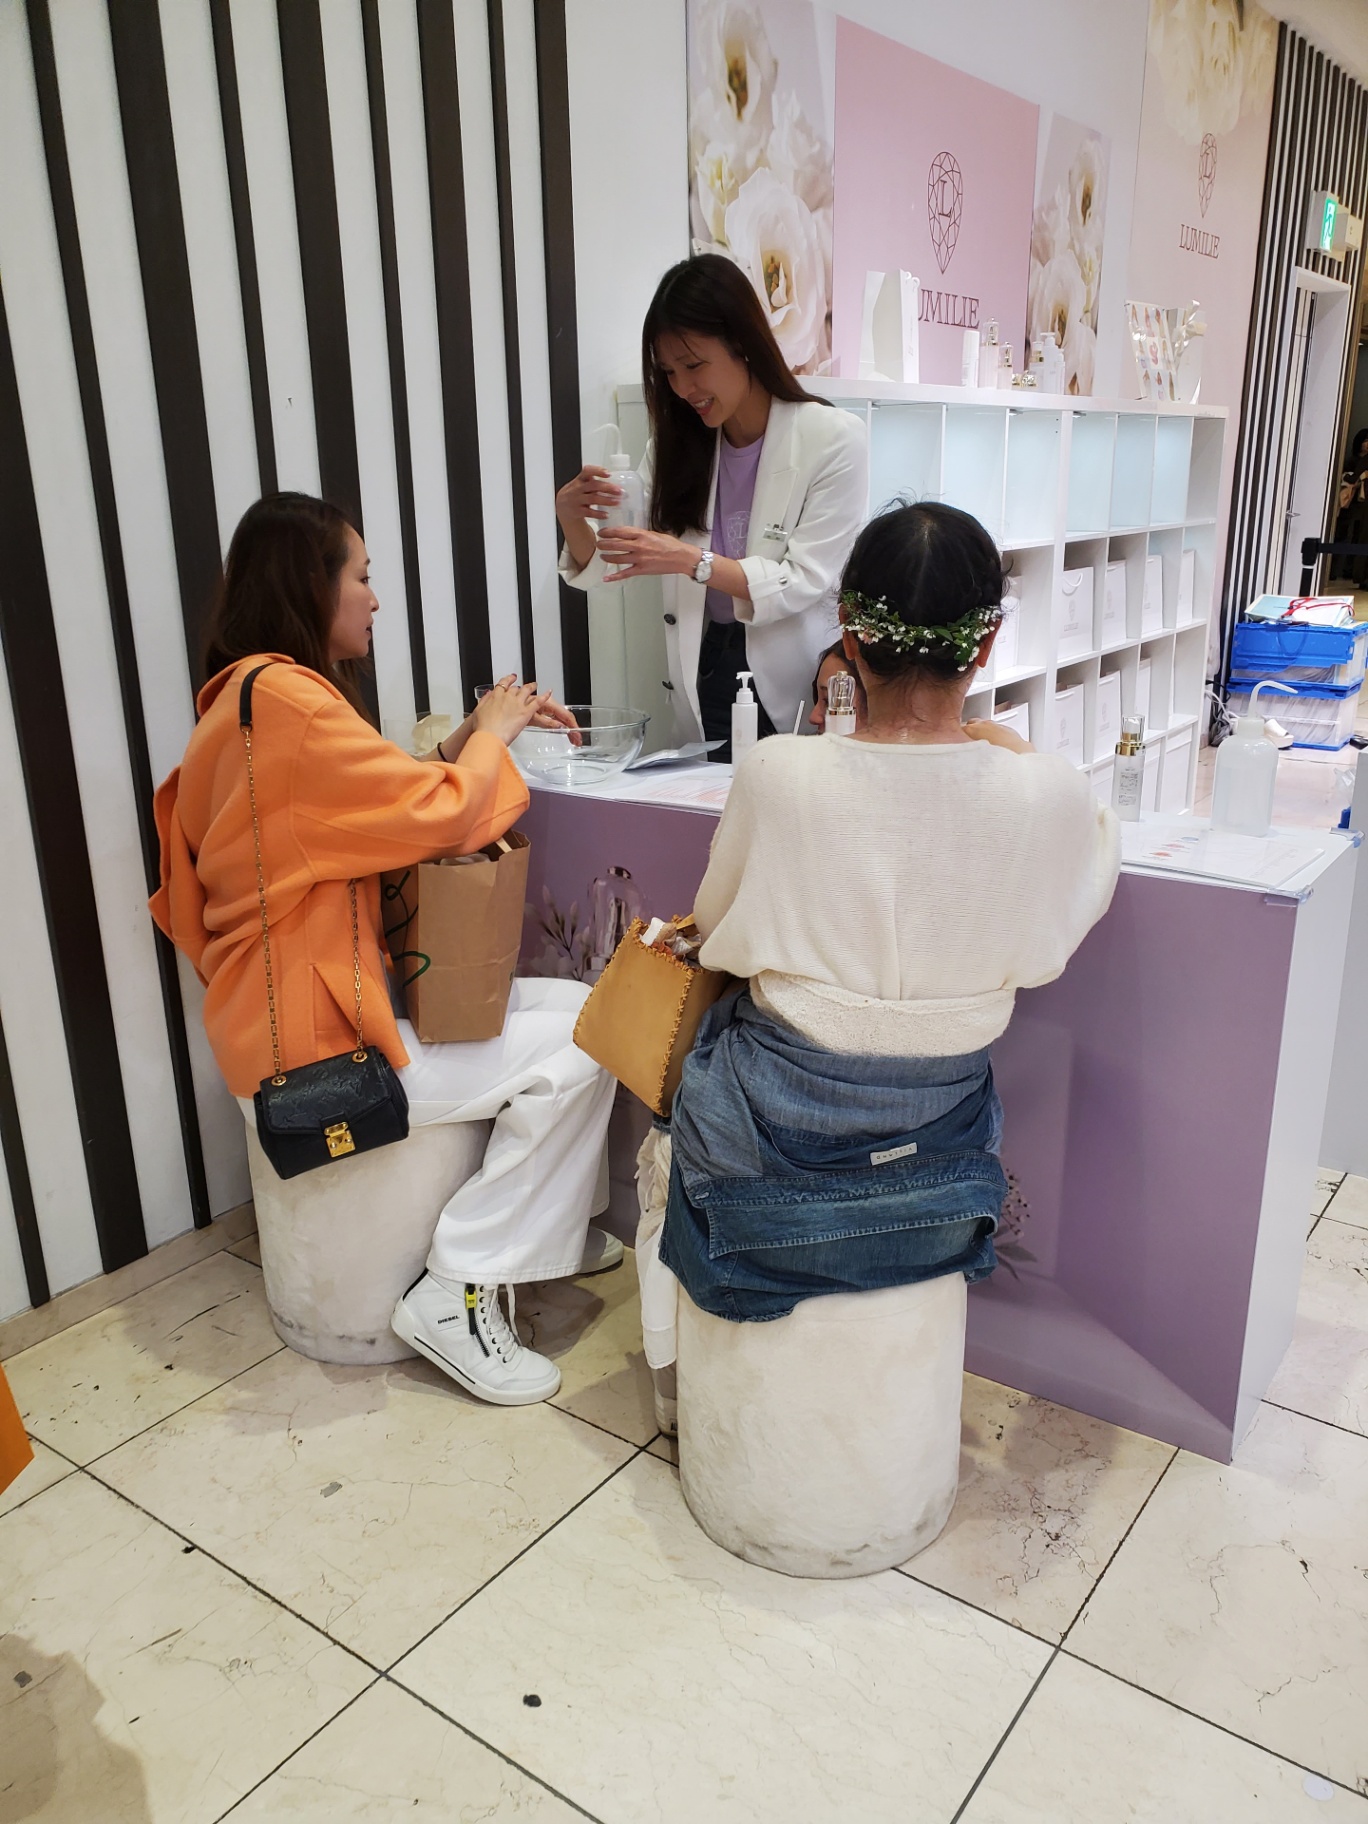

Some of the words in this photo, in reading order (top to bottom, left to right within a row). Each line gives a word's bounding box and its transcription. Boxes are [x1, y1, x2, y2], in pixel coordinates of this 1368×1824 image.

[938, 179, 953, 218] L
[1179, 223, 1220, 259] LUMILIE
[918, 288, 980, 329] MILIE
[437, 1315, 460, 1325] DIESEL
